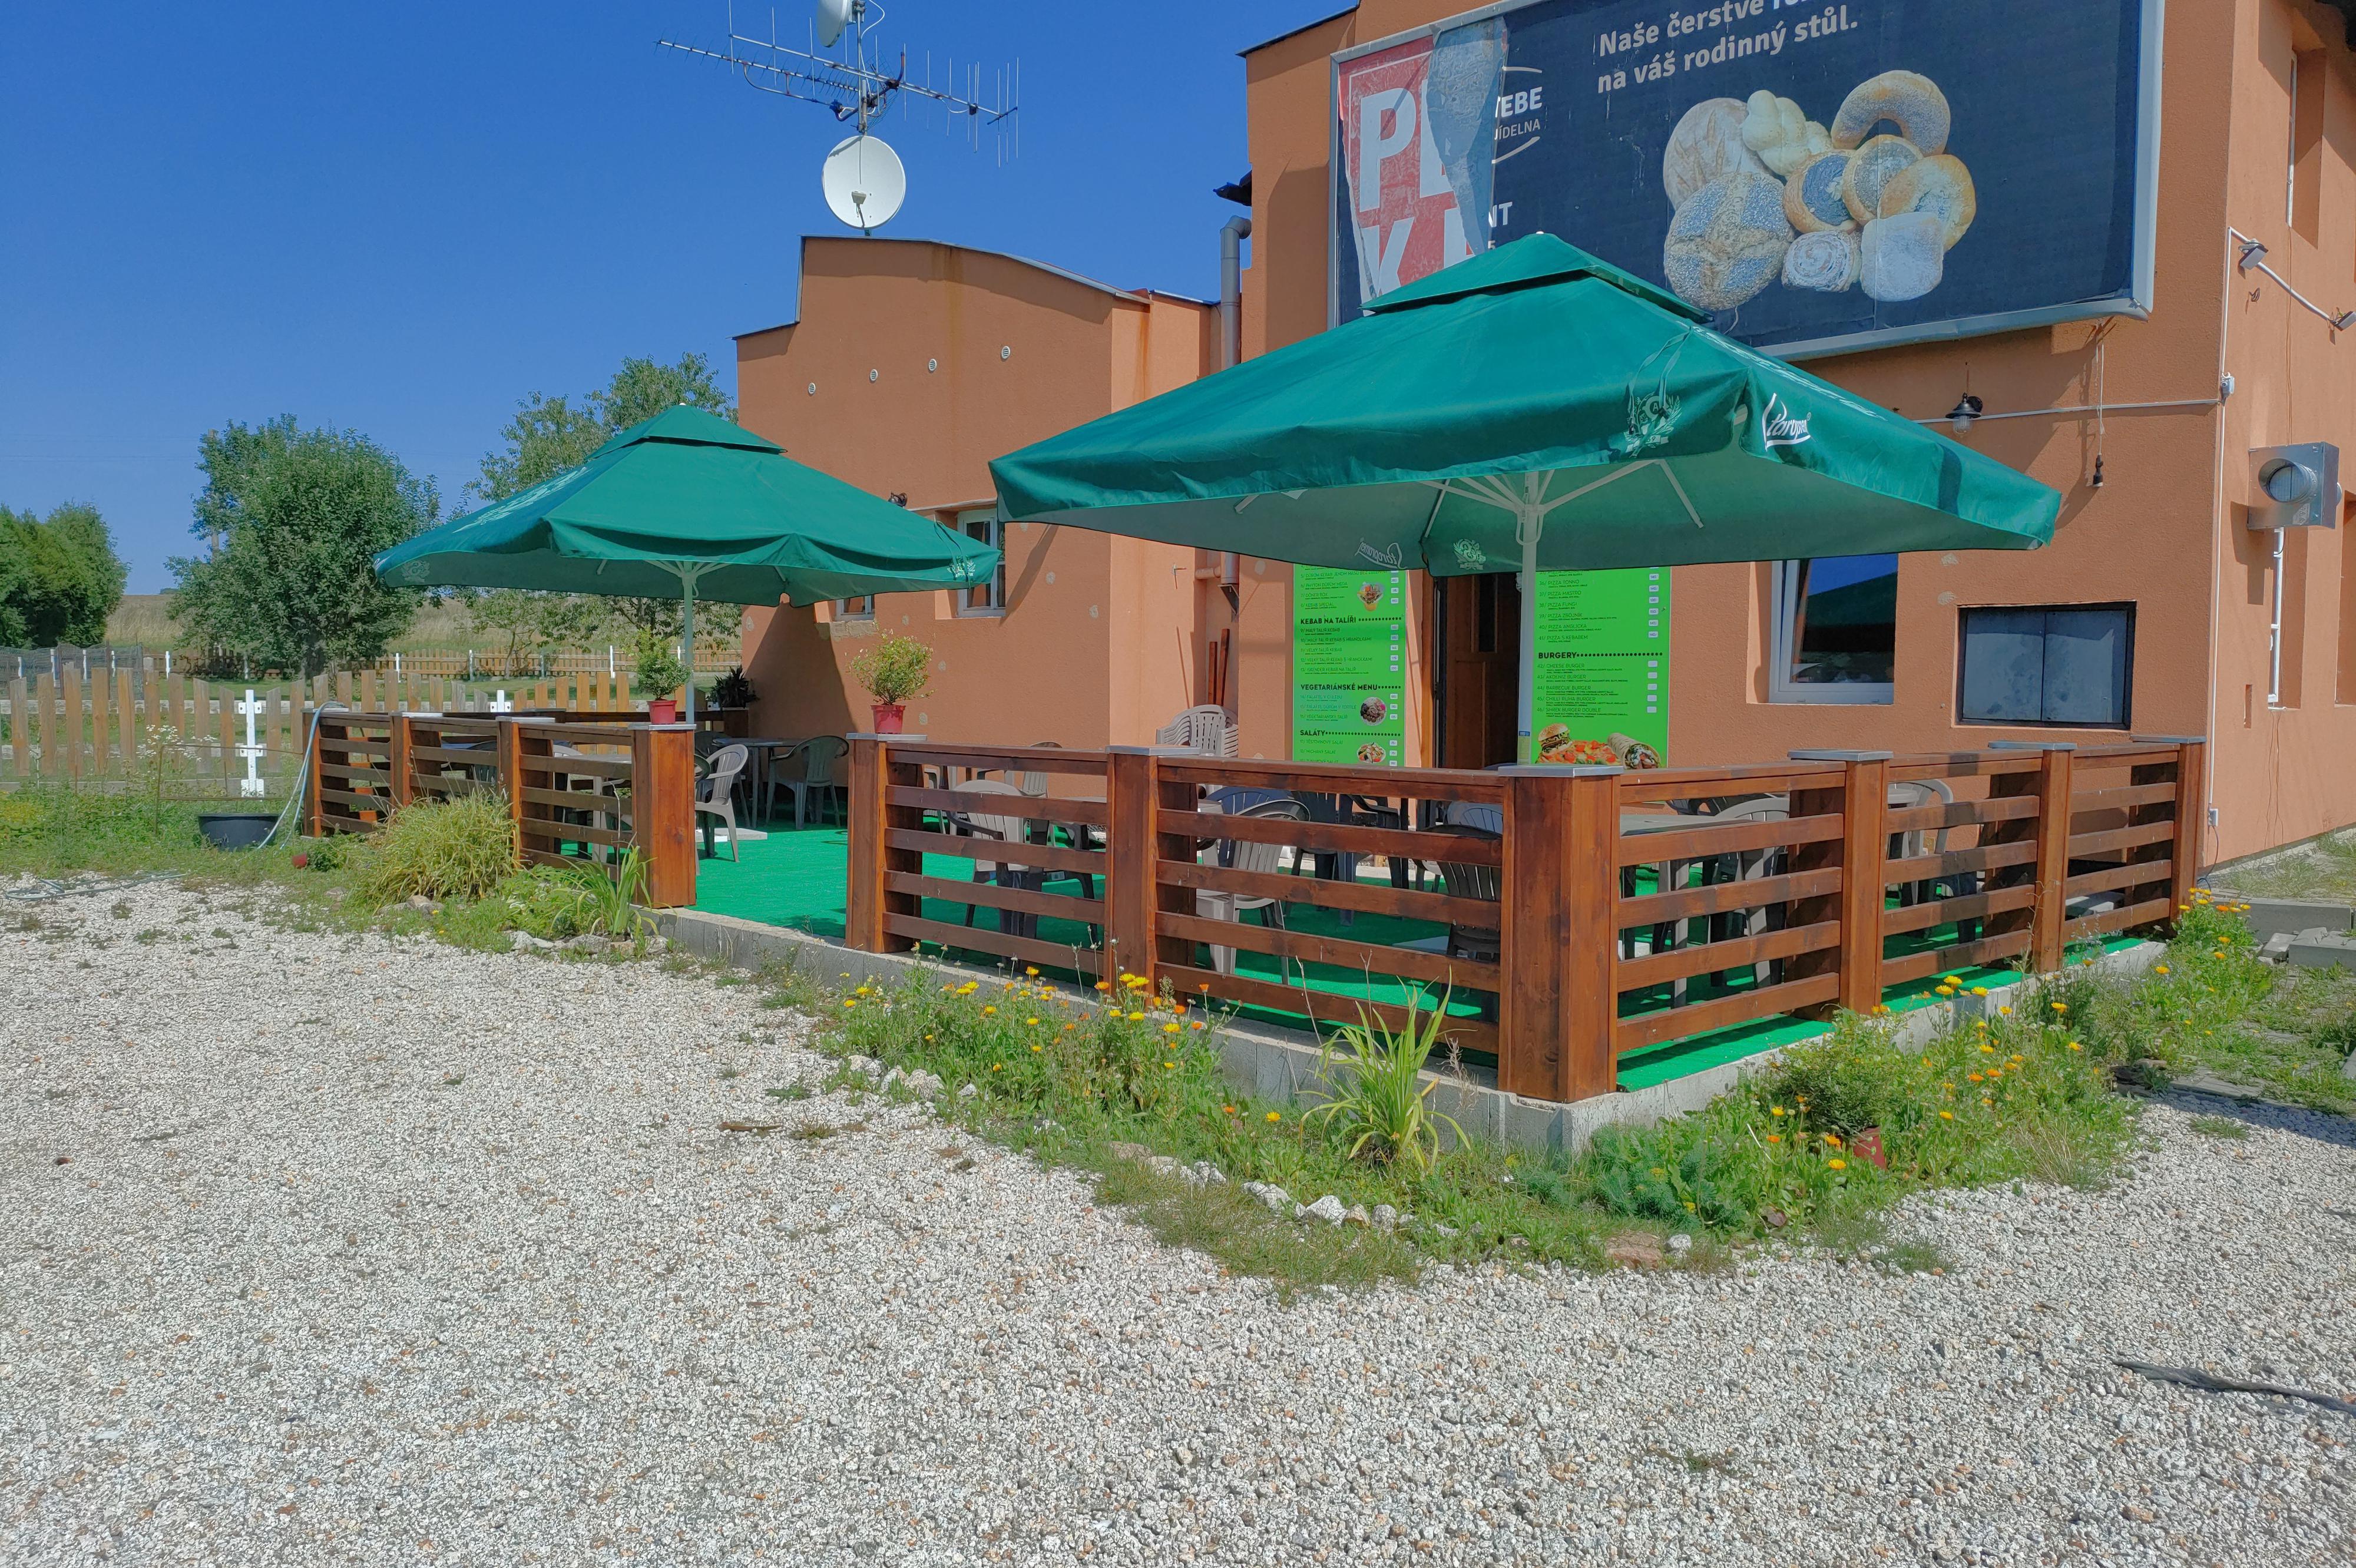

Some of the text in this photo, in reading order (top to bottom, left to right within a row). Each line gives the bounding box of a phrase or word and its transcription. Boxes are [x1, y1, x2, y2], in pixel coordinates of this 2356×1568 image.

[1597, 5, 1858, 94] na váš rodinný stůl.
[1599, 21, 1659, 57] Naše
[1301, 728, 1325, 736] SALÁTY
